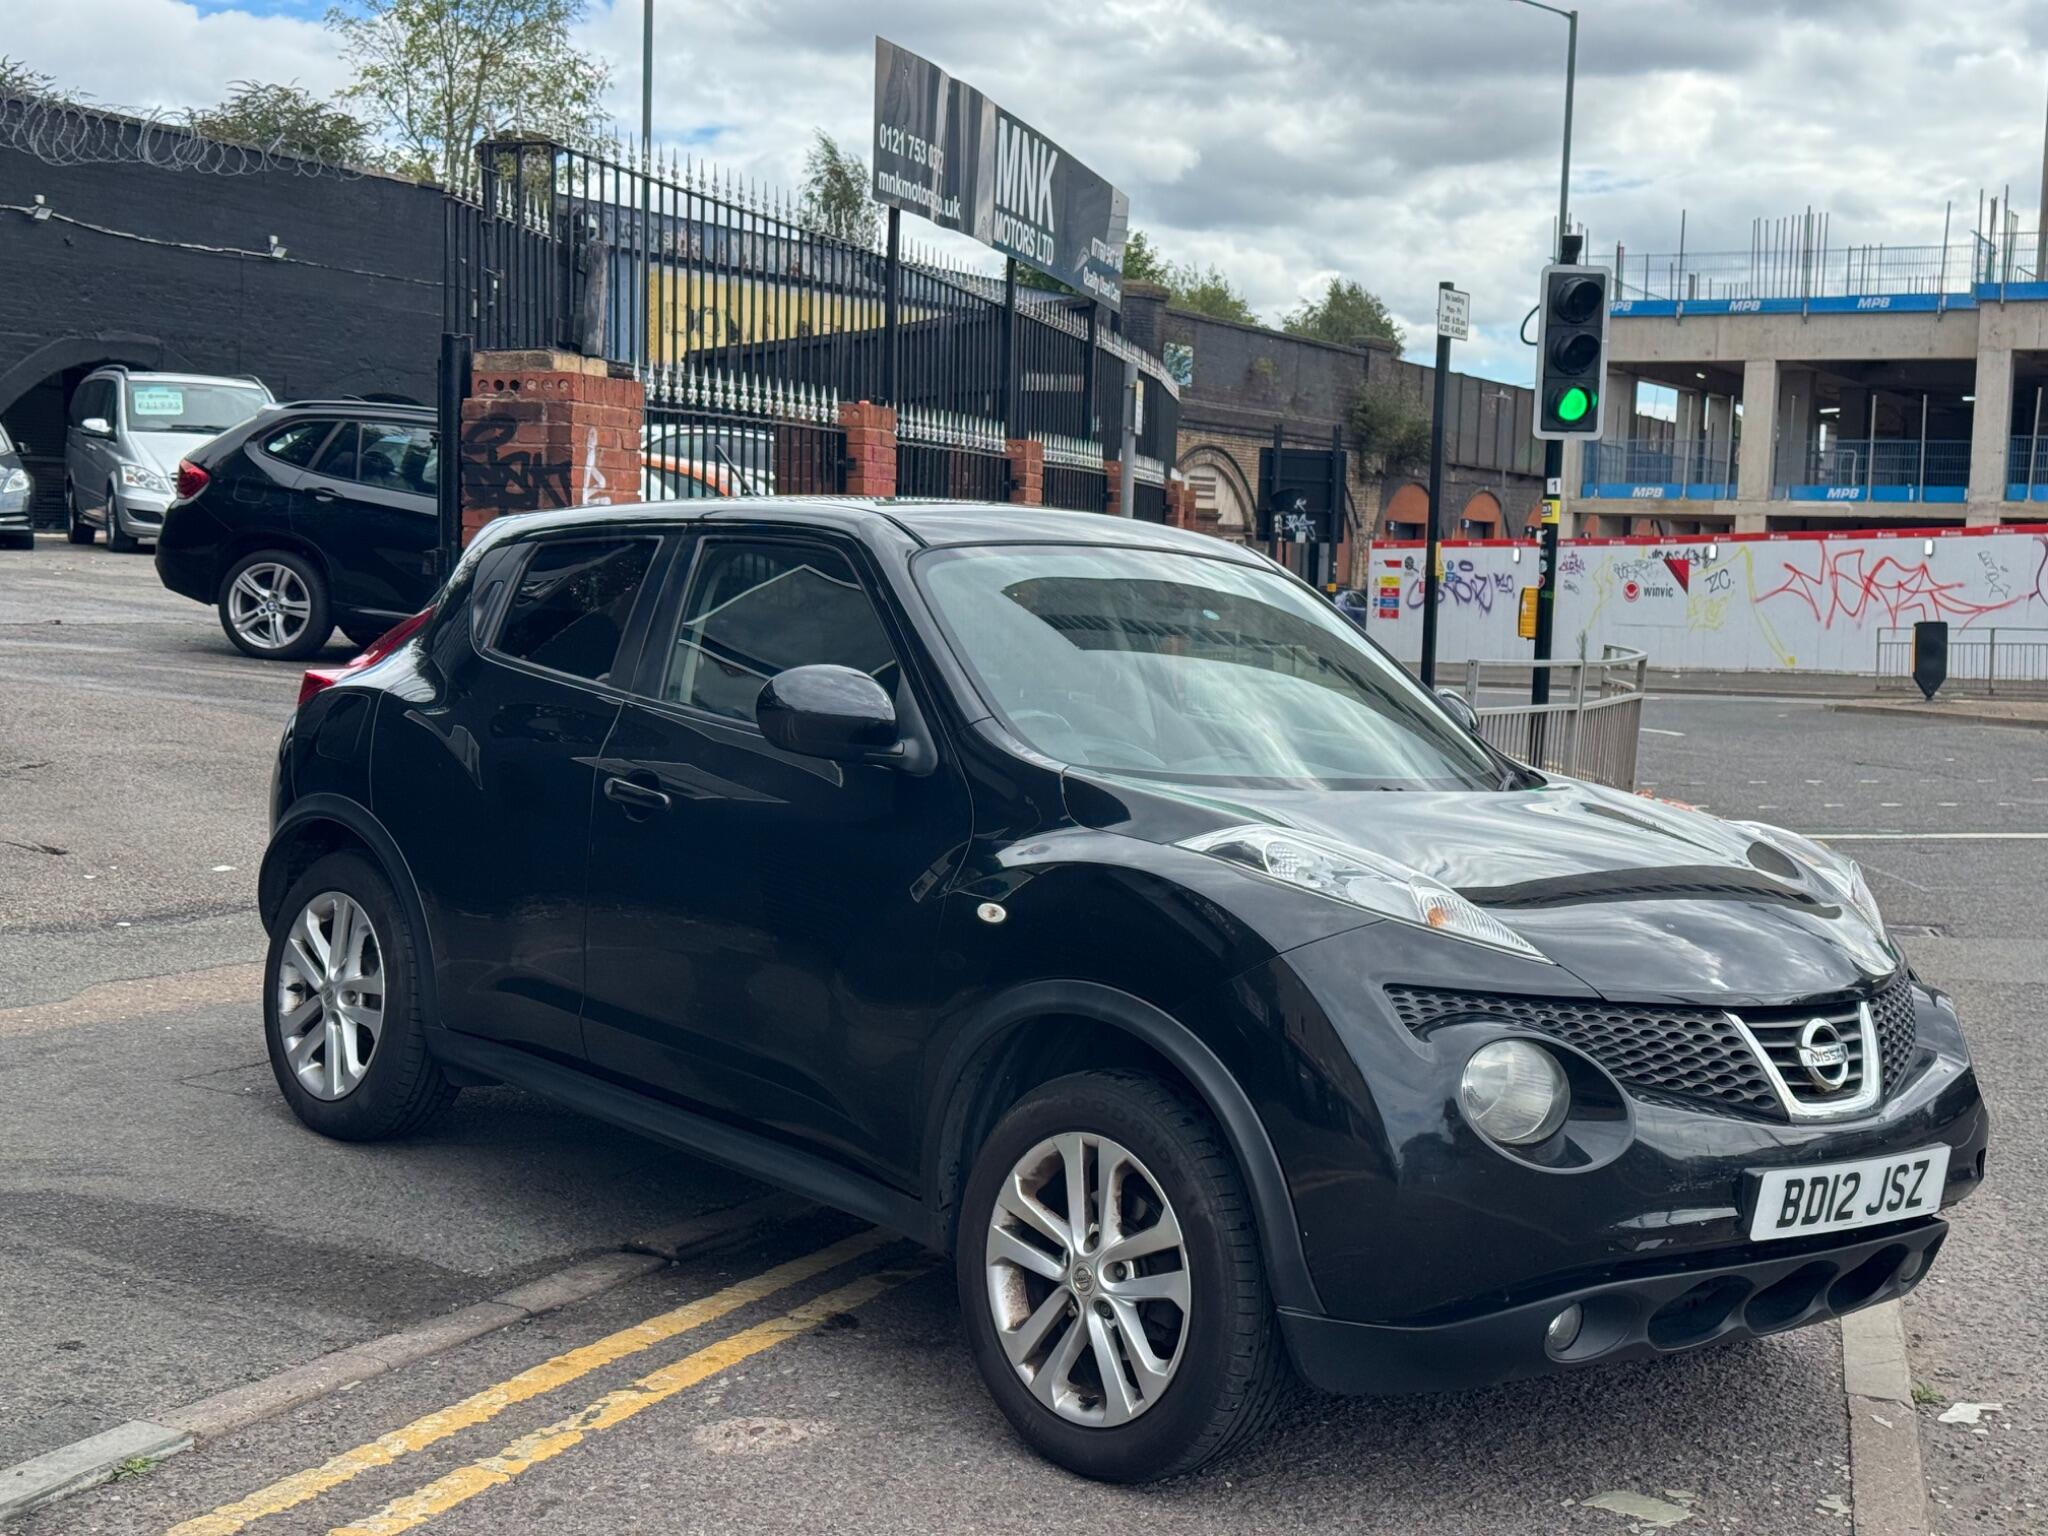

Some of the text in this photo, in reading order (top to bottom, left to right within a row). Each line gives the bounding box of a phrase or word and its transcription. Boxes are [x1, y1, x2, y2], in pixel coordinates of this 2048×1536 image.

[880, 123, 905, 157] 0121
[907, 134, 927, 165] 753
[996, 116, 1058, 233] MNK
[993, 210, 1055, 267] MOTORS LTD
[1729, 301, 1761, 311] MPB
[1857, 297, 1890, 309] MPB
[1551, 480, 1558, 492] 1
[1632, 487, 1663, 498] MPB
[1827, 487, 1858, 498] MPB
[1643, 582, 1674, 598] winvic
[1776, 1159, 1930, 1229] BD12 JSZ
